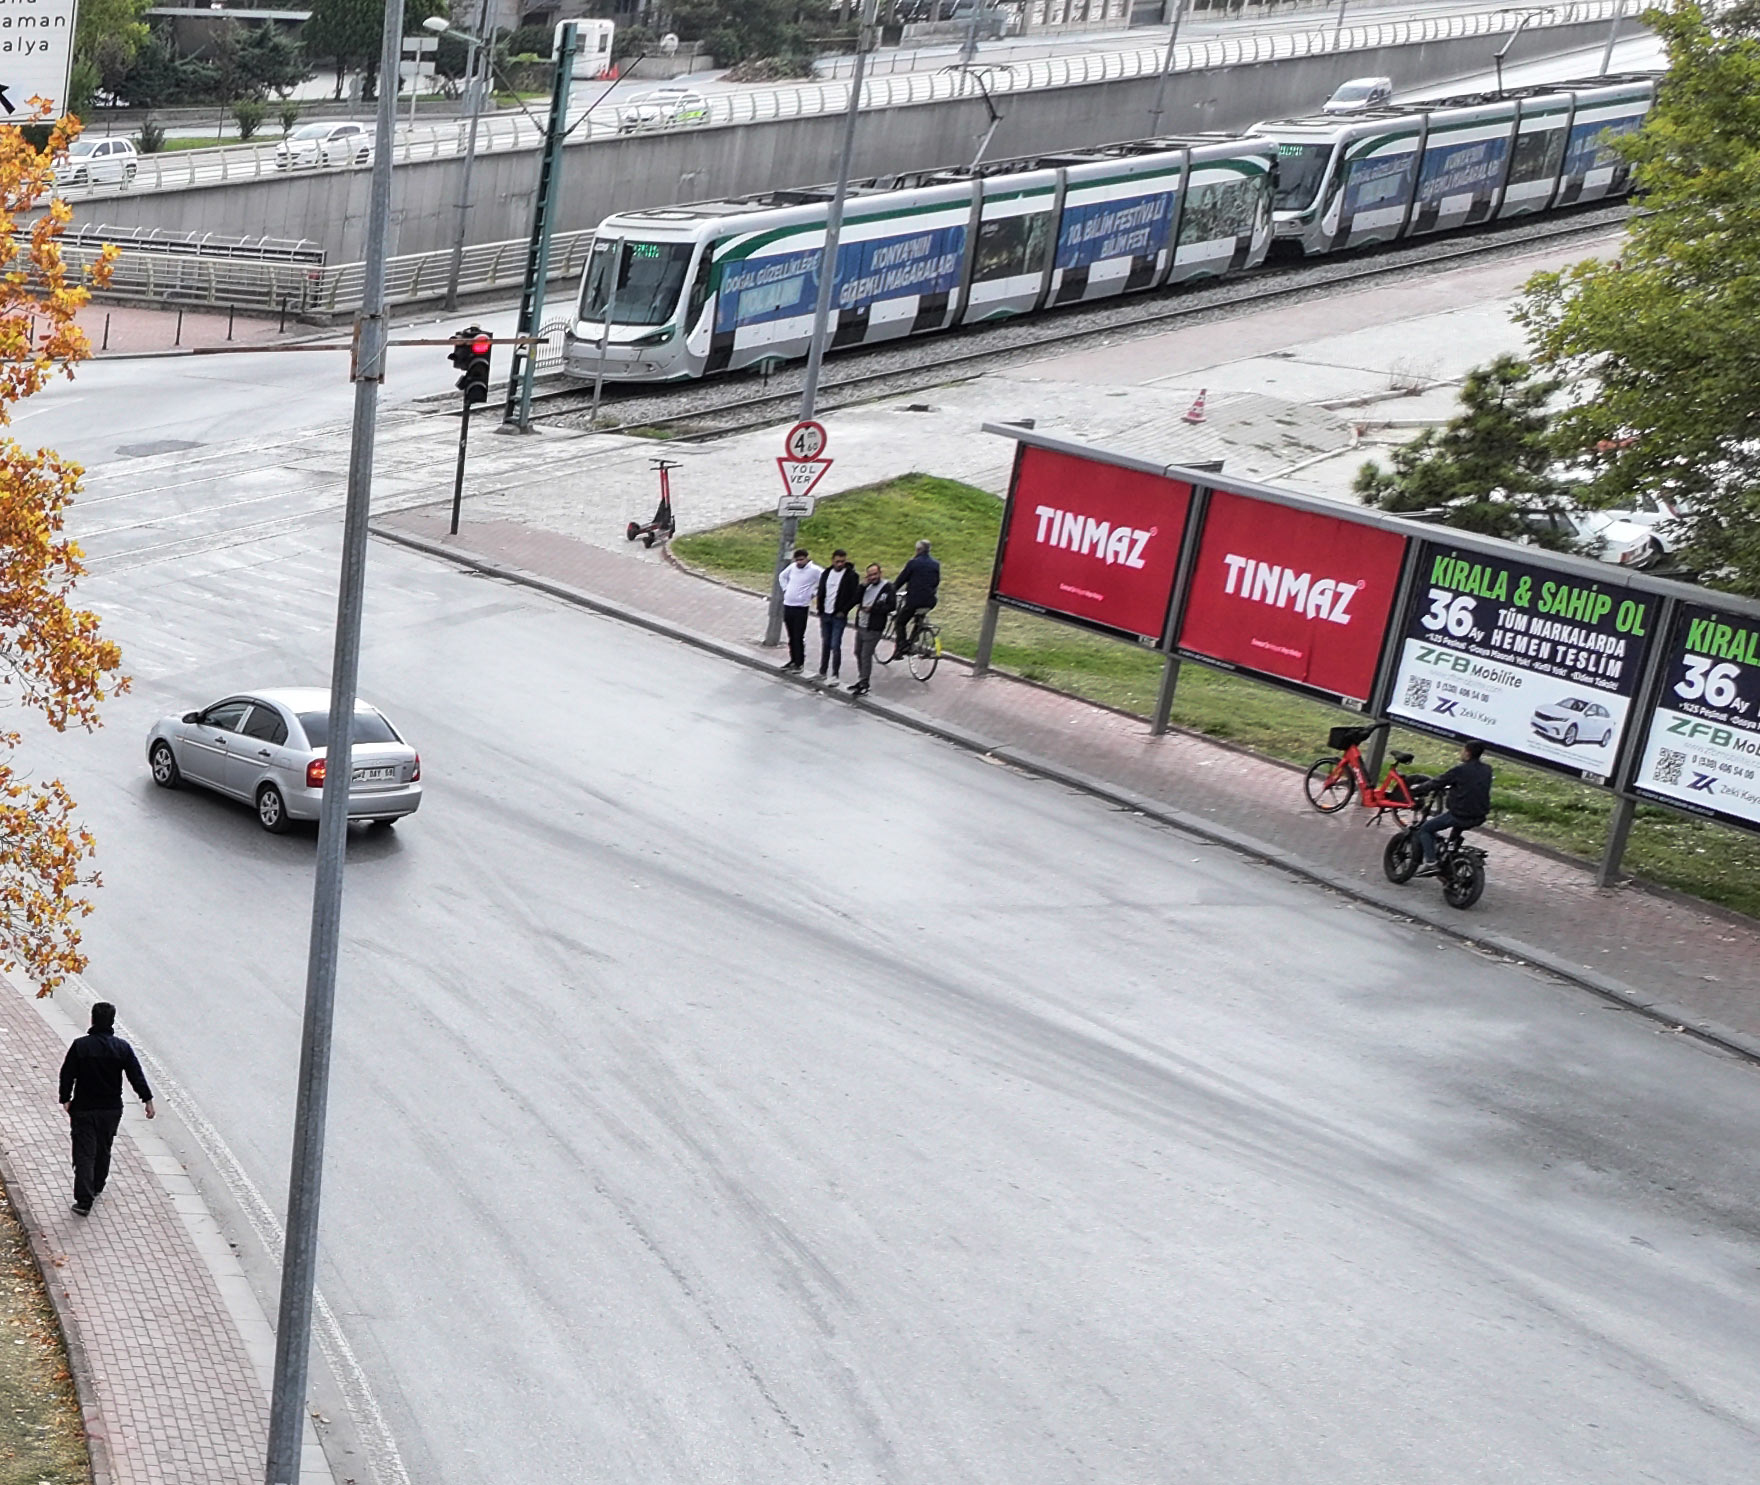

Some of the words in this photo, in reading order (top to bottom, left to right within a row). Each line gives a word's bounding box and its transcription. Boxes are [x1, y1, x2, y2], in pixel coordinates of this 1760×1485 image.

[795, 433, 805, 453] 4
[790, 475, 812, 484] VER
[792, 465, 816, 474] YOL
[1035, 505, 1152, 569] TINMAZ
[1224, 554, 1358, 624] TINMAZ
[1430, 551, 1509, 602] KİRALA
[1513, 576, 1532, 608] &
[1538, 584, 1612, 625] SAHİP
[1616, 600, 1646, 636] OL
[1421, 588, 1478, 637] 36
[1468, 627, 1485, 642] Ay
[1497, 607, 1529, 633] TÜM
[1529, 617, 1627, 657] MARKALARDA
[1490, 629, 1551, 660] HEMEN
[1556, 645, 1624, 679] TESLİM
[1685, 614, 1760, 667] KİRAL
[1416, 646, 1471, 673] ZFB
[1471, 664, 1523, 689] Mobilite
[1674, 653, 1741, 707] 36
[1730, 697, 1750, 714] Ay
[1666, 715, 1733, 747] ZFB
